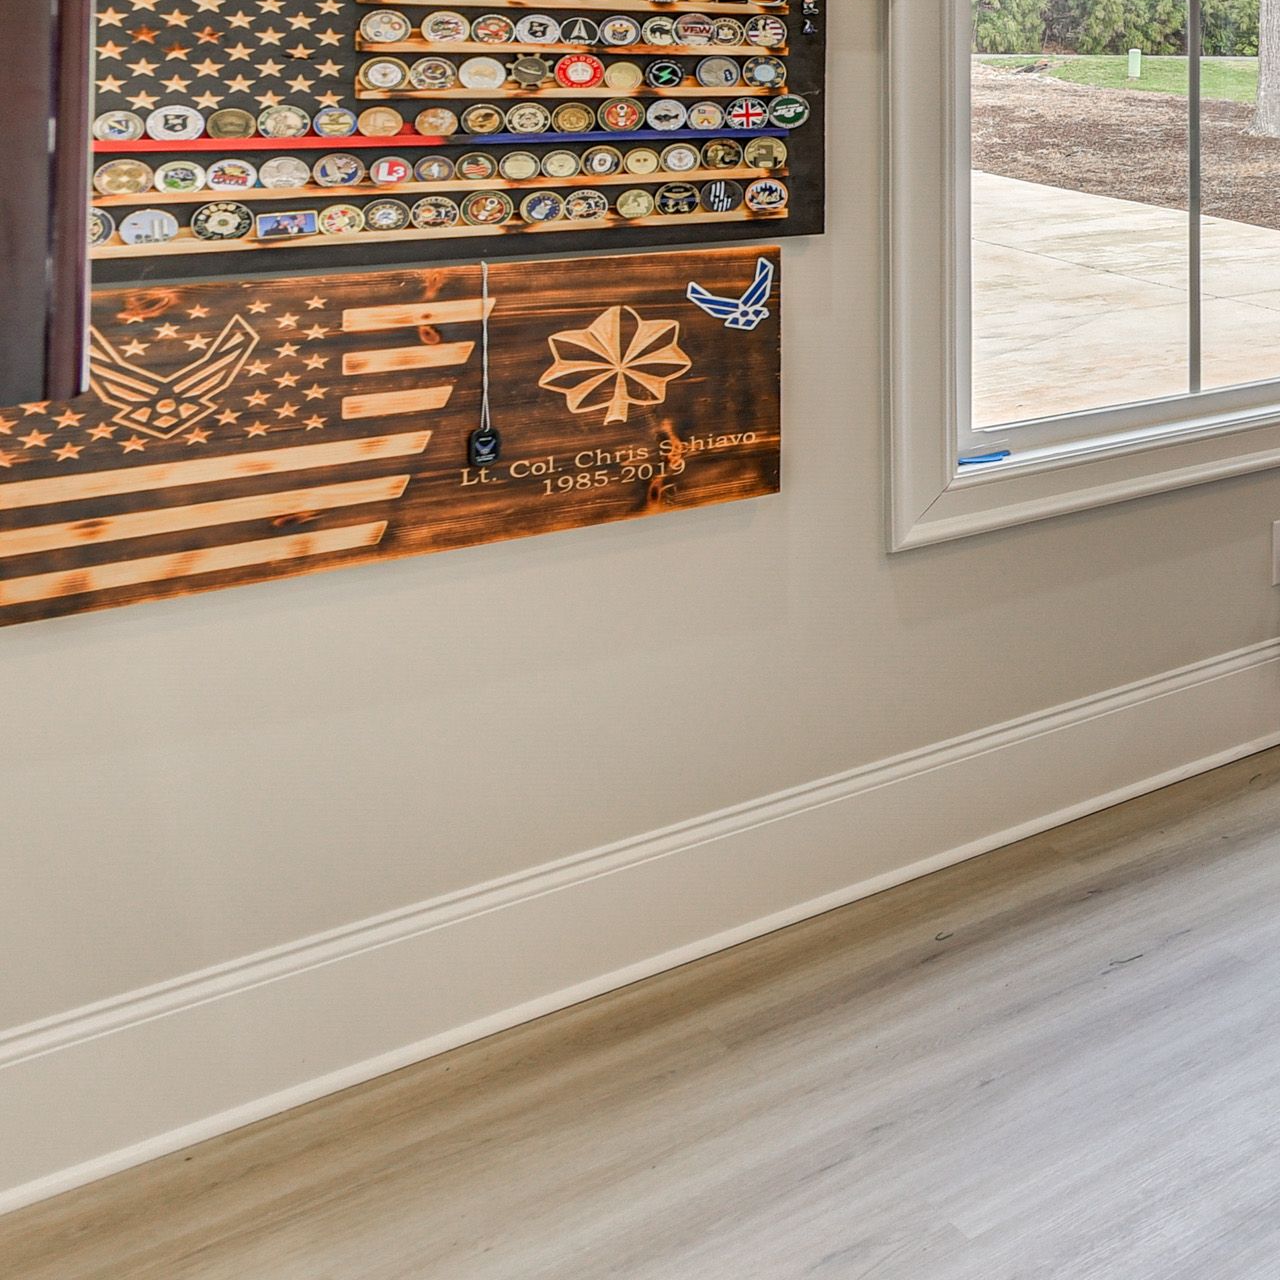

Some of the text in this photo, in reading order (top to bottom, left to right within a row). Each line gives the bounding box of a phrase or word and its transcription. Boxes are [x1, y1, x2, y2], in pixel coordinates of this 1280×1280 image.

[682, 25, 712, 35] VFW
[560, 56, 599, 68] LONDON
[377, 161, 405, 181] L3
[460, 431, 756, 486] Lt. Col. Chris Schiavo
[542, 458, 686, 496] 1985-2019
